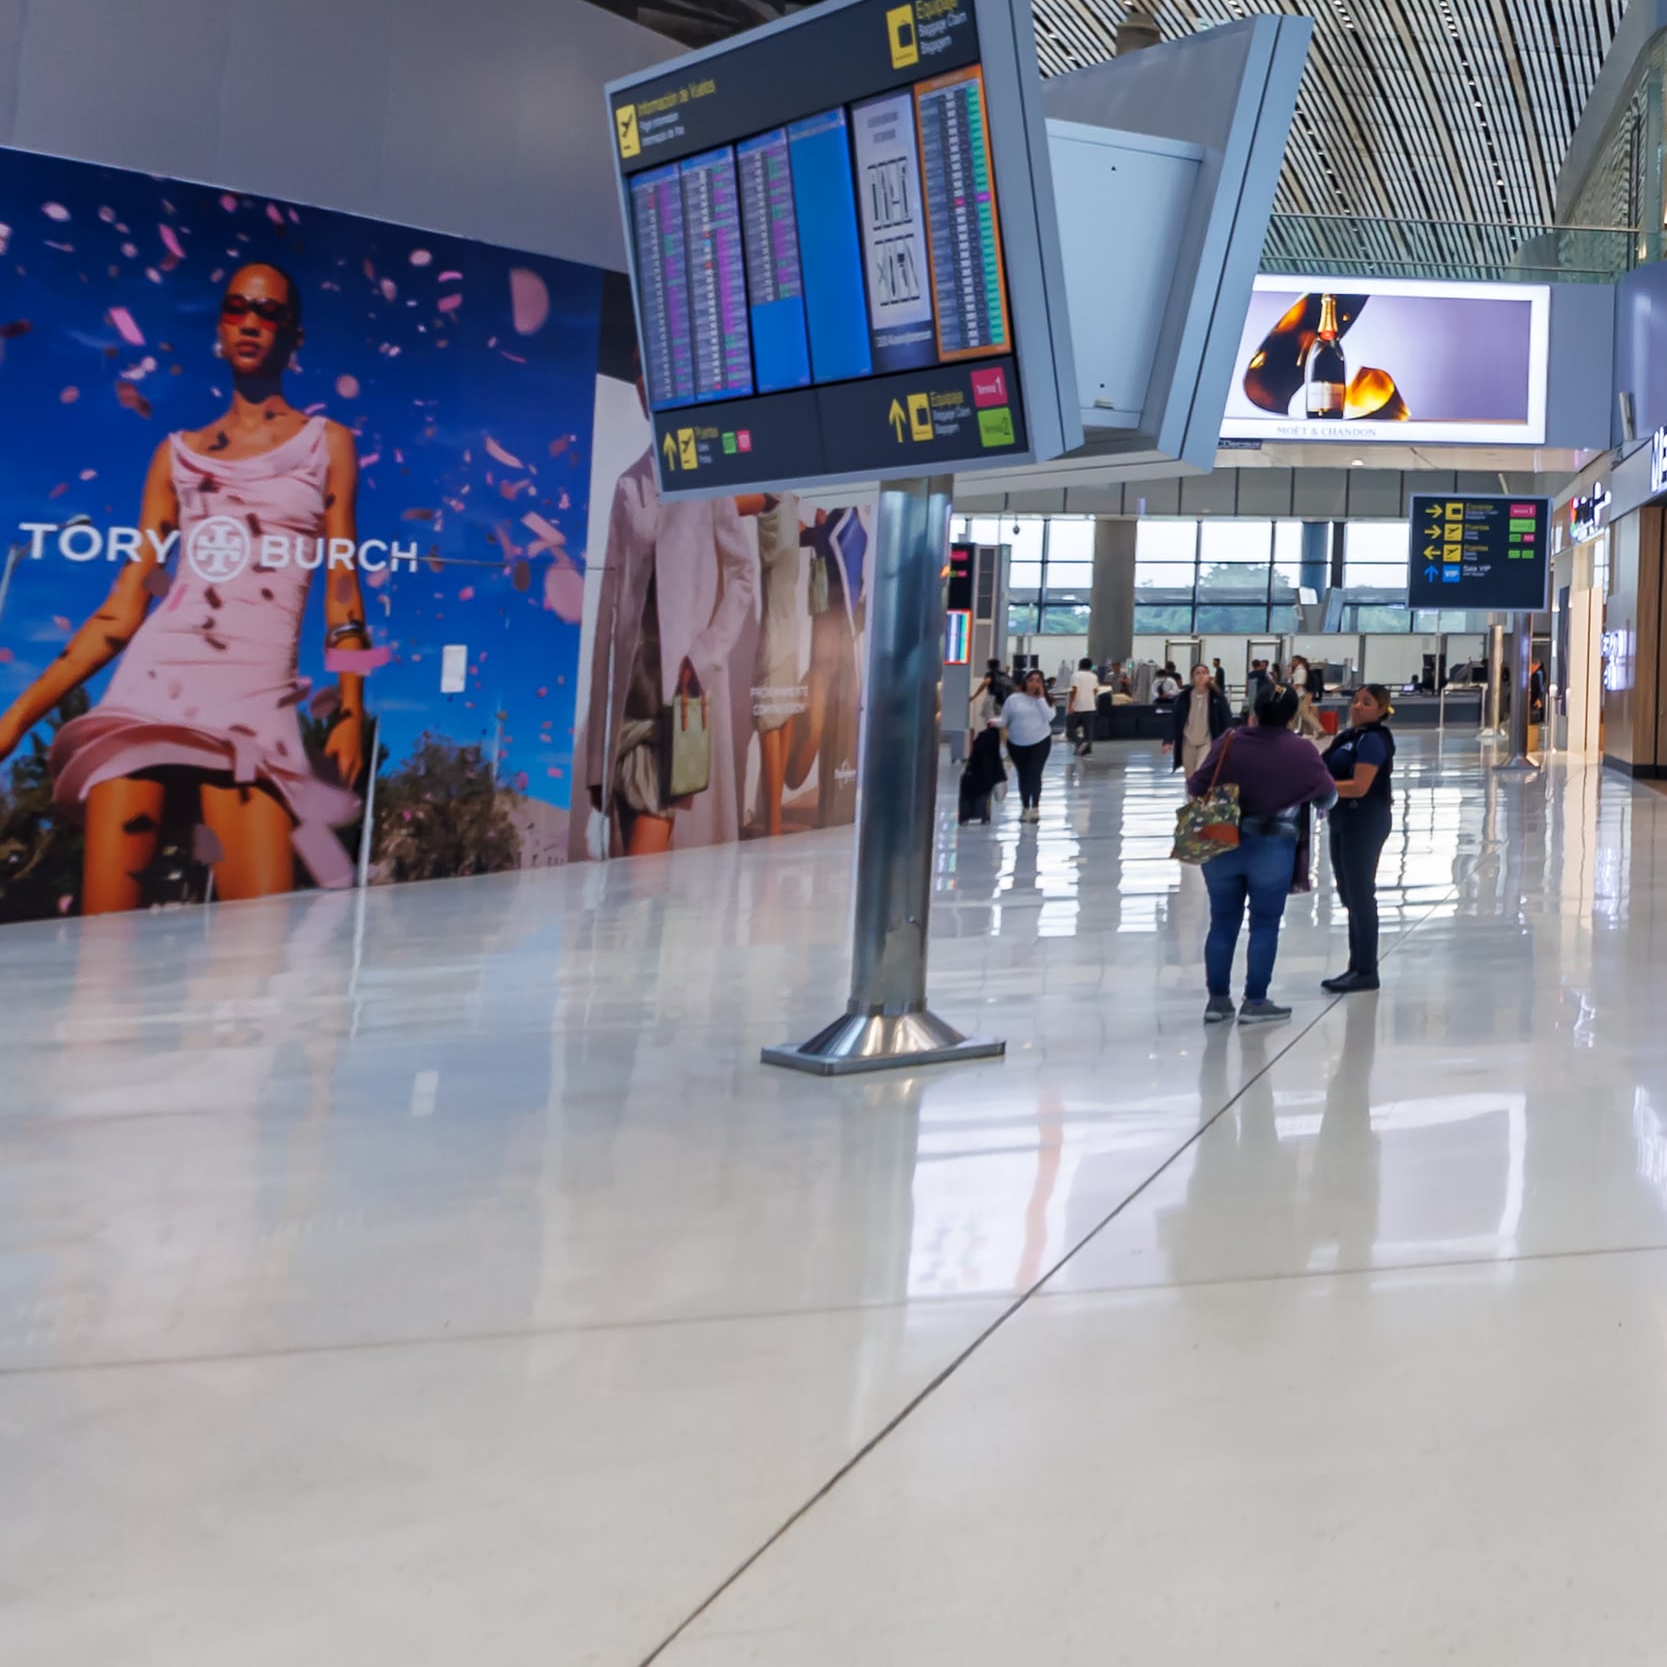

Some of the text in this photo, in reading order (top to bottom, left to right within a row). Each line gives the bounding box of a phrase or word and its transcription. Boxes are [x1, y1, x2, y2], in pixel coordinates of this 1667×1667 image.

[1321, 426, 1377, 437] CHANDON
[18, 521, 420, 574] TORY BURCH
